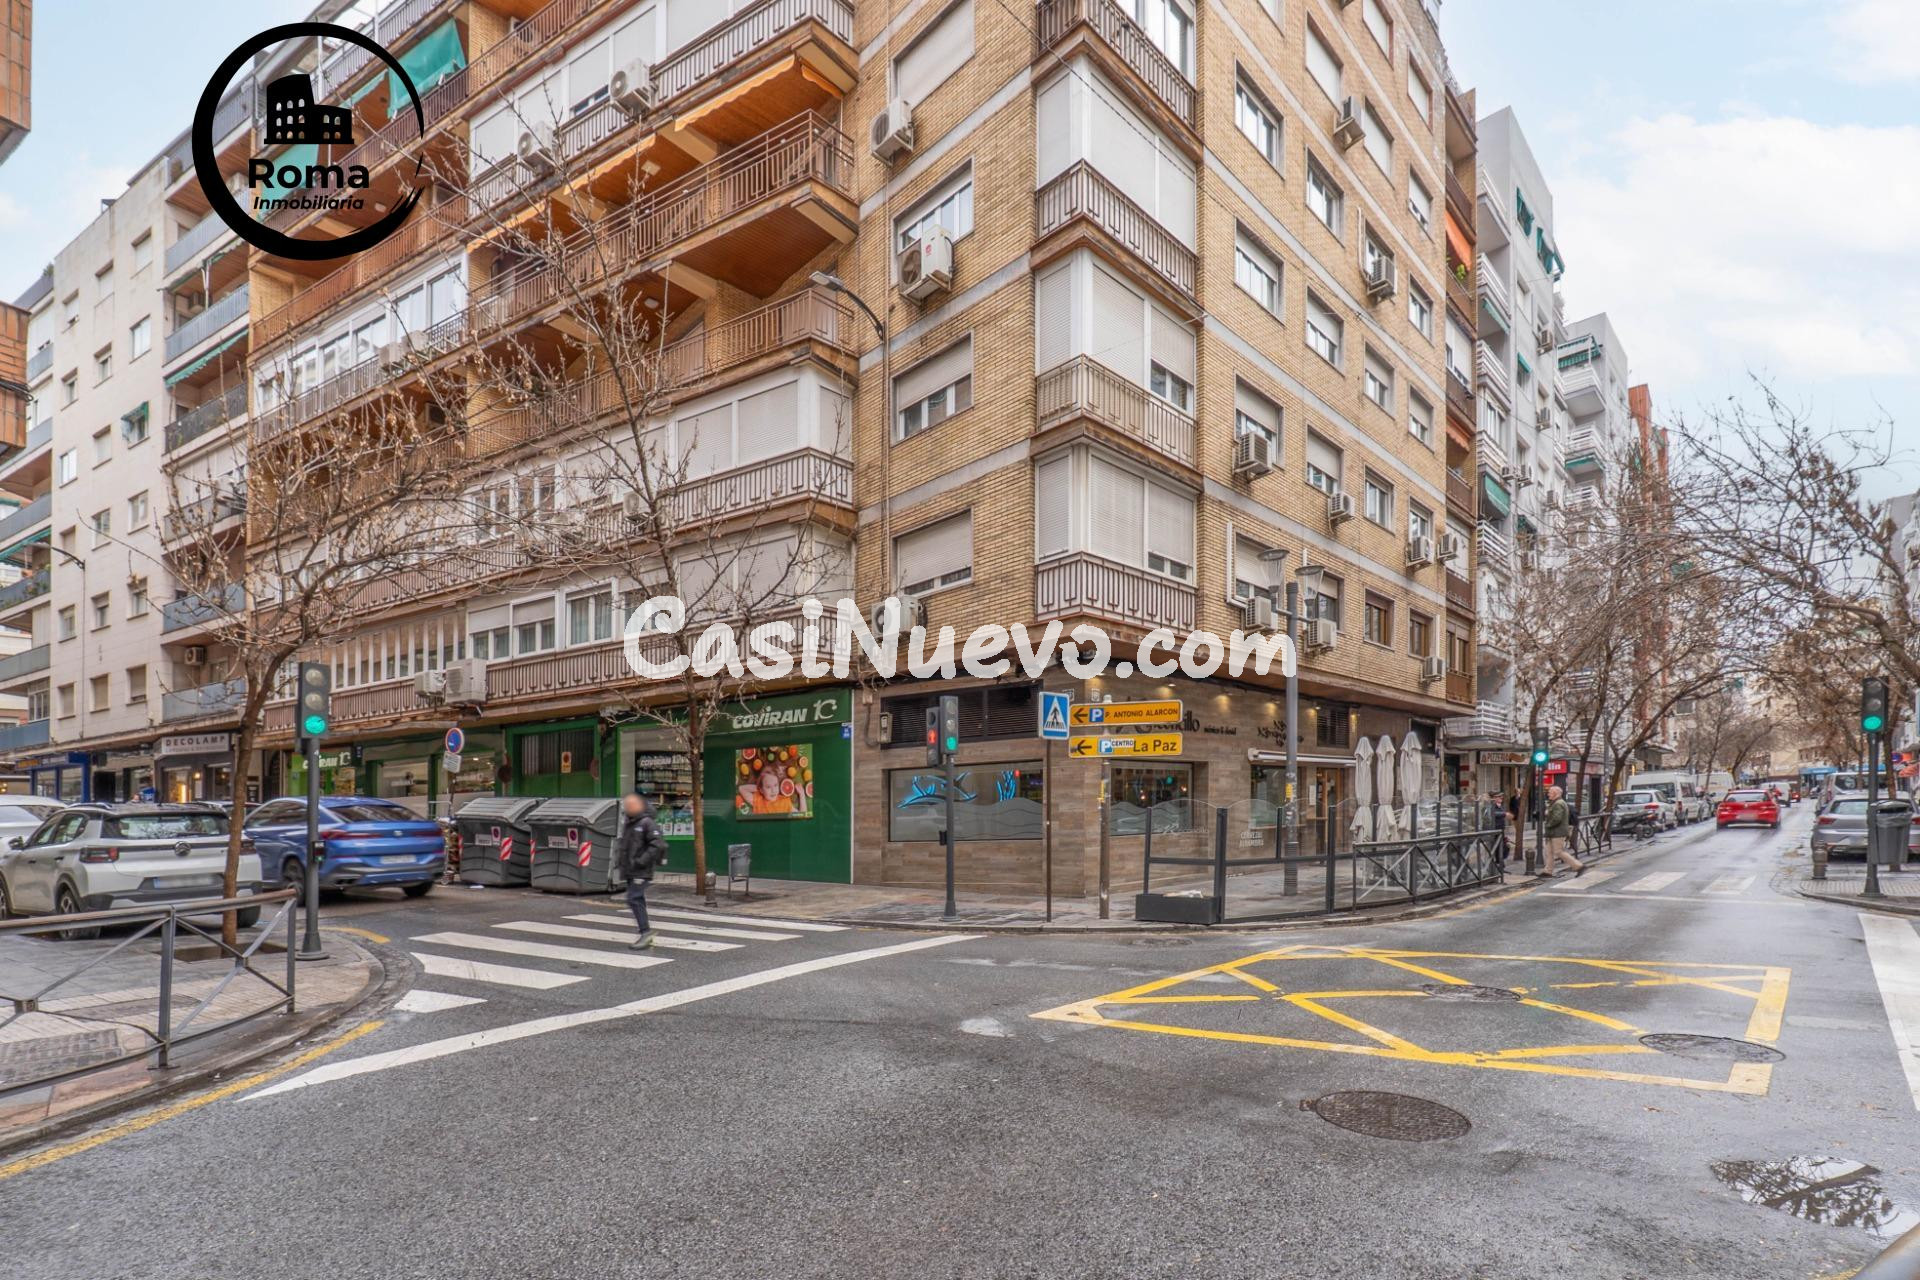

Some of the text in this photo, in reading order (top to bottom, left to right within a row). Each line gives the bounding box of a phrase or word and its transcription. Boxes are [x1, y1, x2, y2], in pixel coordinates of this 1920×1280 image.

[1114, 710, 1143, 718] ANTONIO
[1146, 709, 1178, 717] ALARCON
[166, 735, 225, 746] DECOLAMP
[1133, 741, 1148, 752] La
[1153, 740, 1177, 752] Paz
